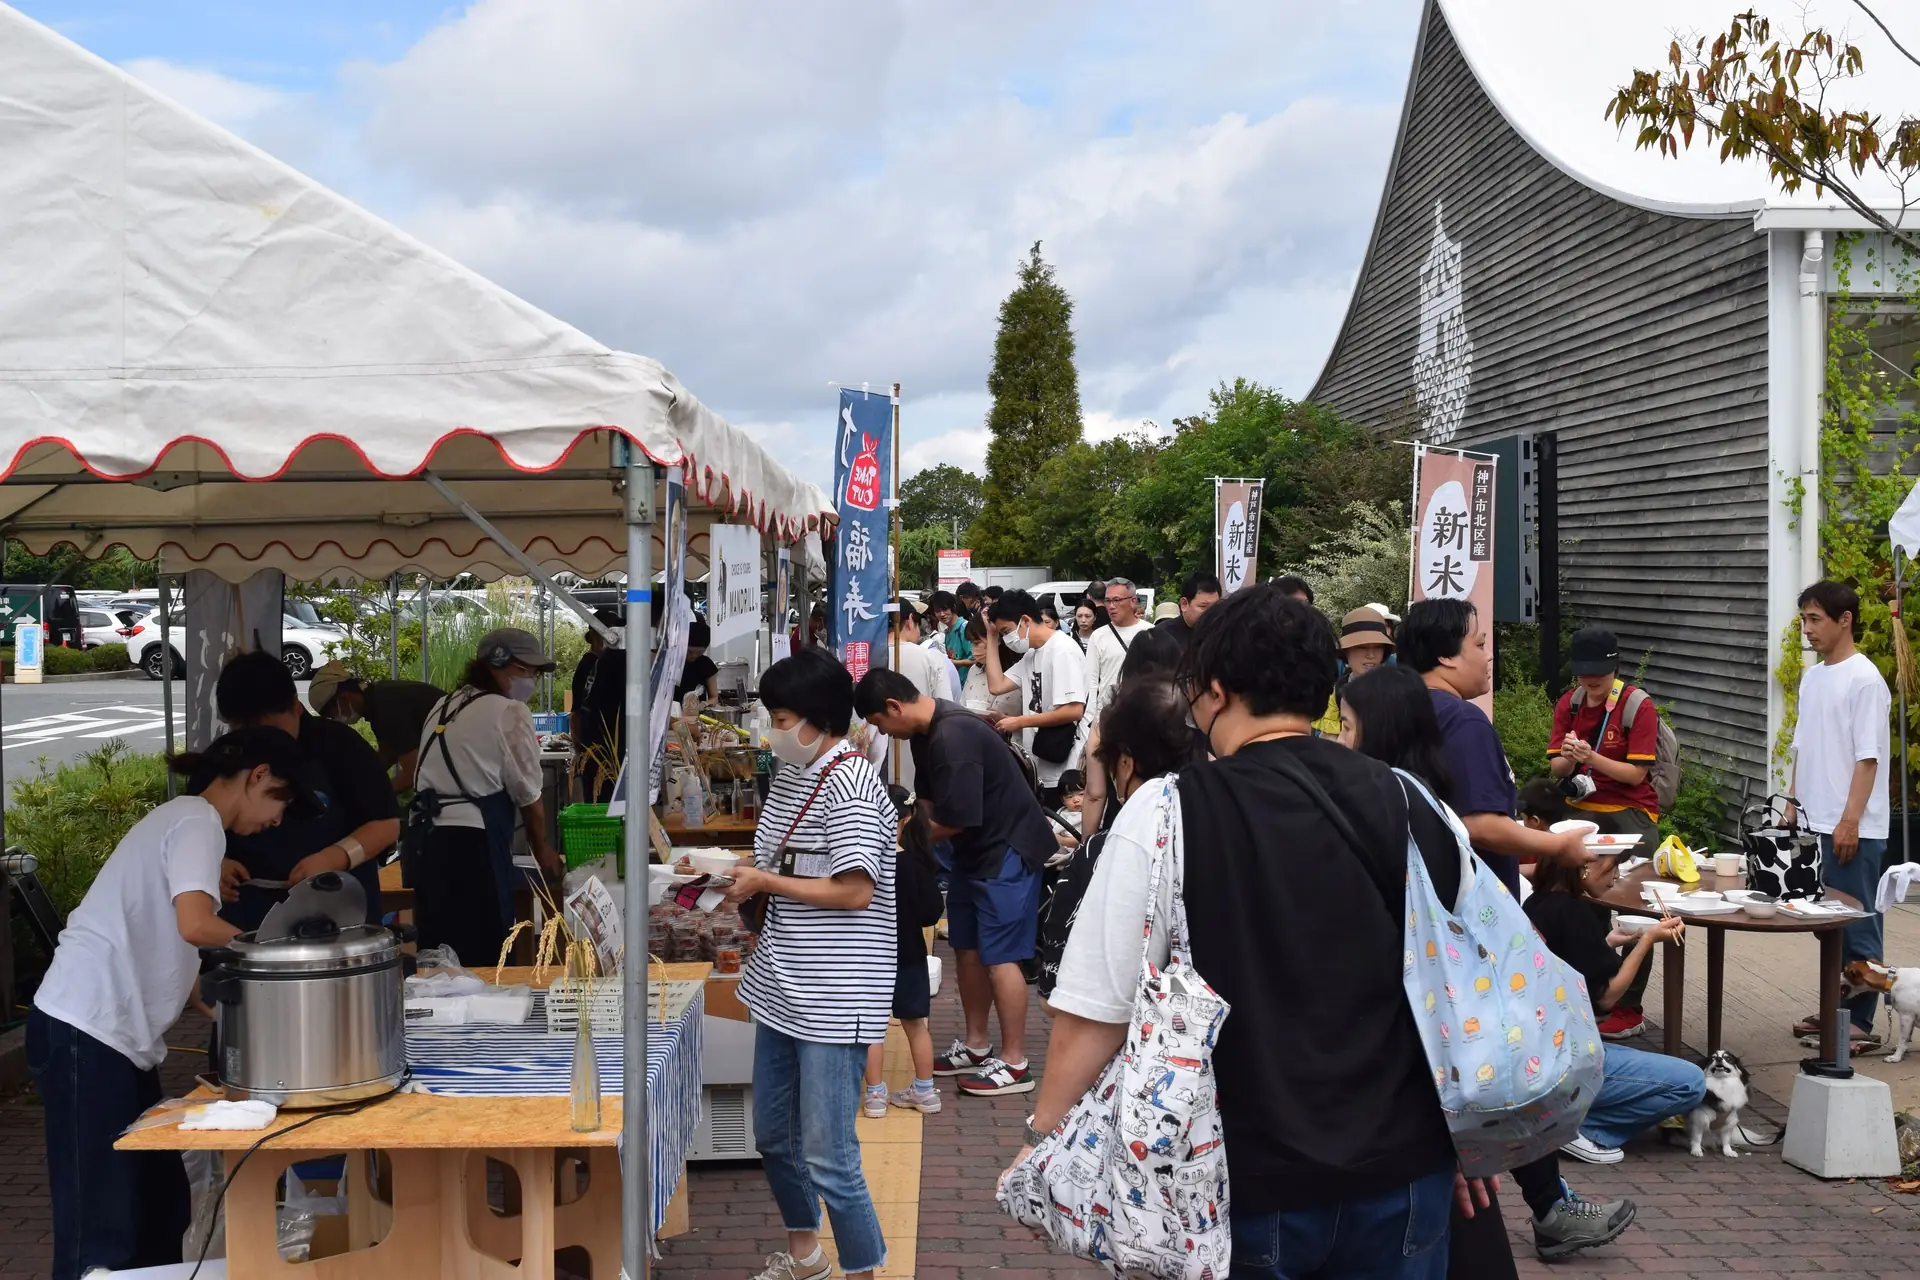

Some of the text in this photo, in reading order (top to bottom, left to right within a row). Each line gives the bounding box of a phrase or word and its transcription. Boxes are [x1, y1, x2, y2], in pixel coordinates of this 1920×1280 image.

[1245, 490, 1259, 554] 神戸市北区産
[1472, 470, 1489, 556] 神戸市北区産
[1225, 519, 1245, 584] 新米
[1427, 506, 1469, 596] 新米
[988, 1068, 1016, 1087] N
